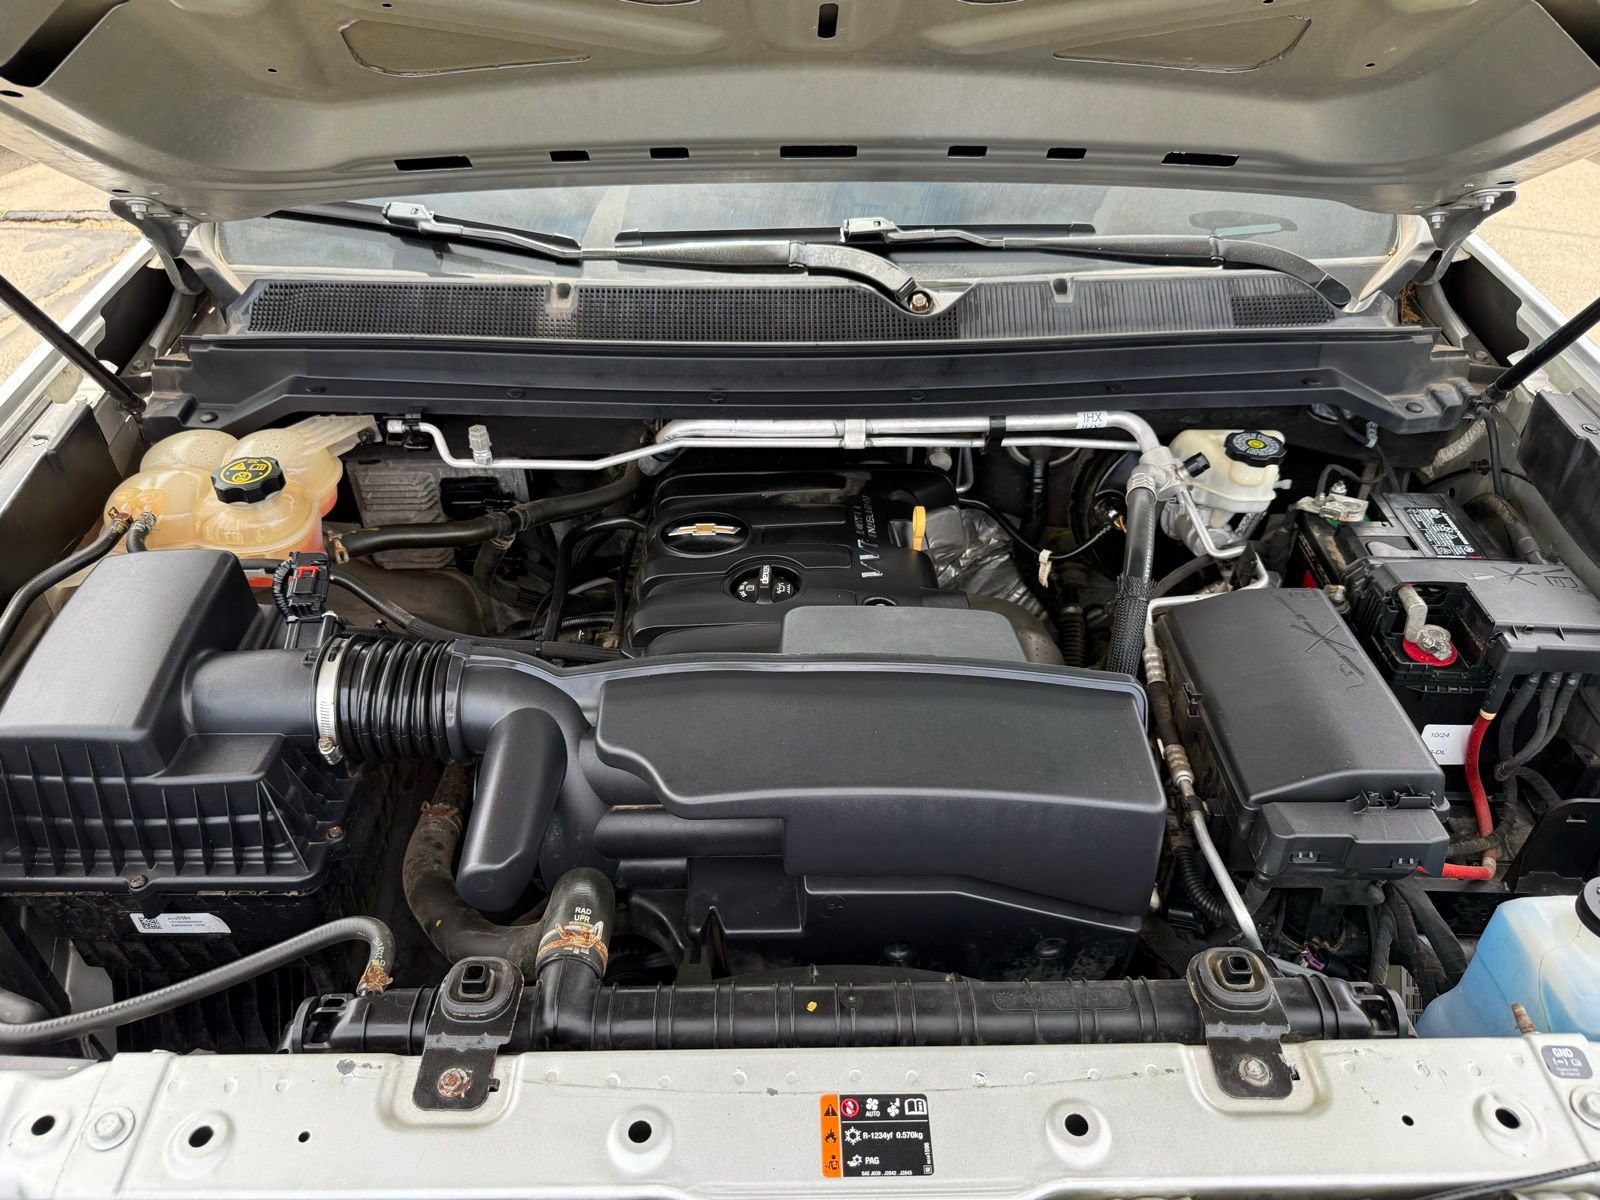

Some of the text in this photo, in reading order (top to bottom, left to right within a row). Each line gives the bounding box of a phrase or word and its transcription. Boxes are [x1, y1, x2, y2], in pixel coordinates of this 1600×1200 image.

[575, 906, 592, 915] RAD
[574, 914, 590, 923] UPR
[1551, 1047, 1574, 1058] GND
[862, 1131, 924, 1140] R-1234yf 0.570kg
[865, 1156, 880, 1164] PAG
